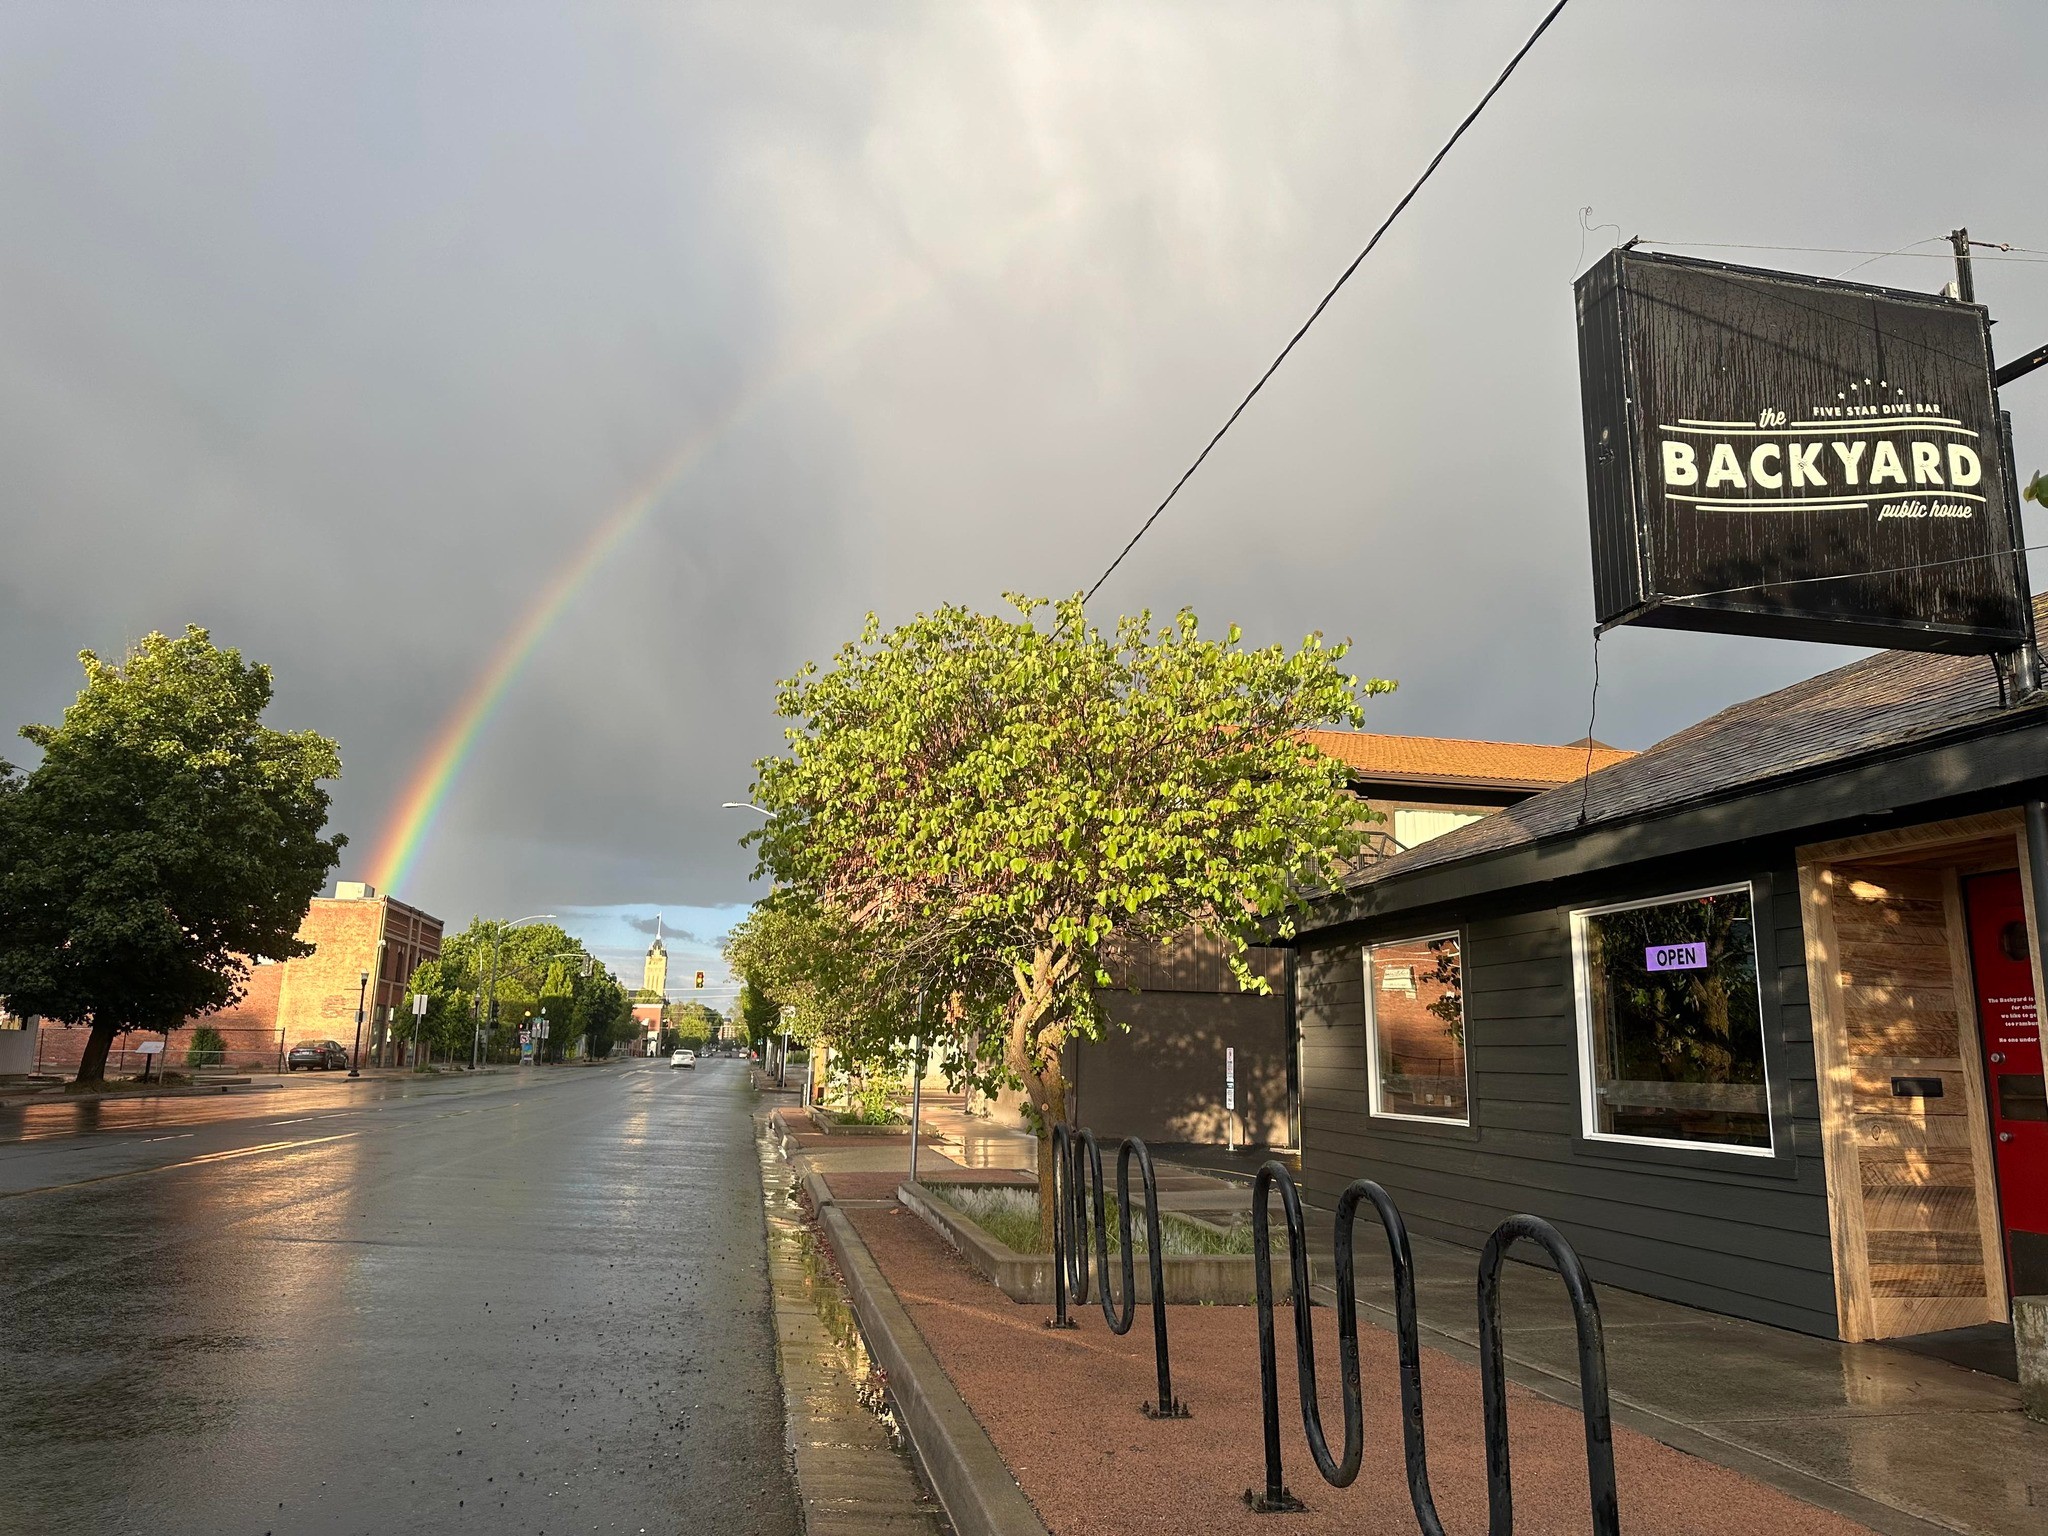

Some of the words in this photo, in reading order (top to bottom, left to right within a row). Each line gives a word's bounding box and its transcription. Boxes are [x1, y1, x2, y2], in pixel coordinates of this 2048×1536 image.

[1759, 407, 1787, 428] the
[1812, 406, 1841, 417] FIVE
[1846, 405, 1878, 416] STAR
[1882, 403, 1912, 415] DIVE
[1916, 403, 1941, 414] BAR
[1661, 440, 1983, 489] BACKYARD
[1877, 500, 1928, 522] public
[1928, 499, 1973, 519] house
[1657, 947, 1696, 966] OPEN
